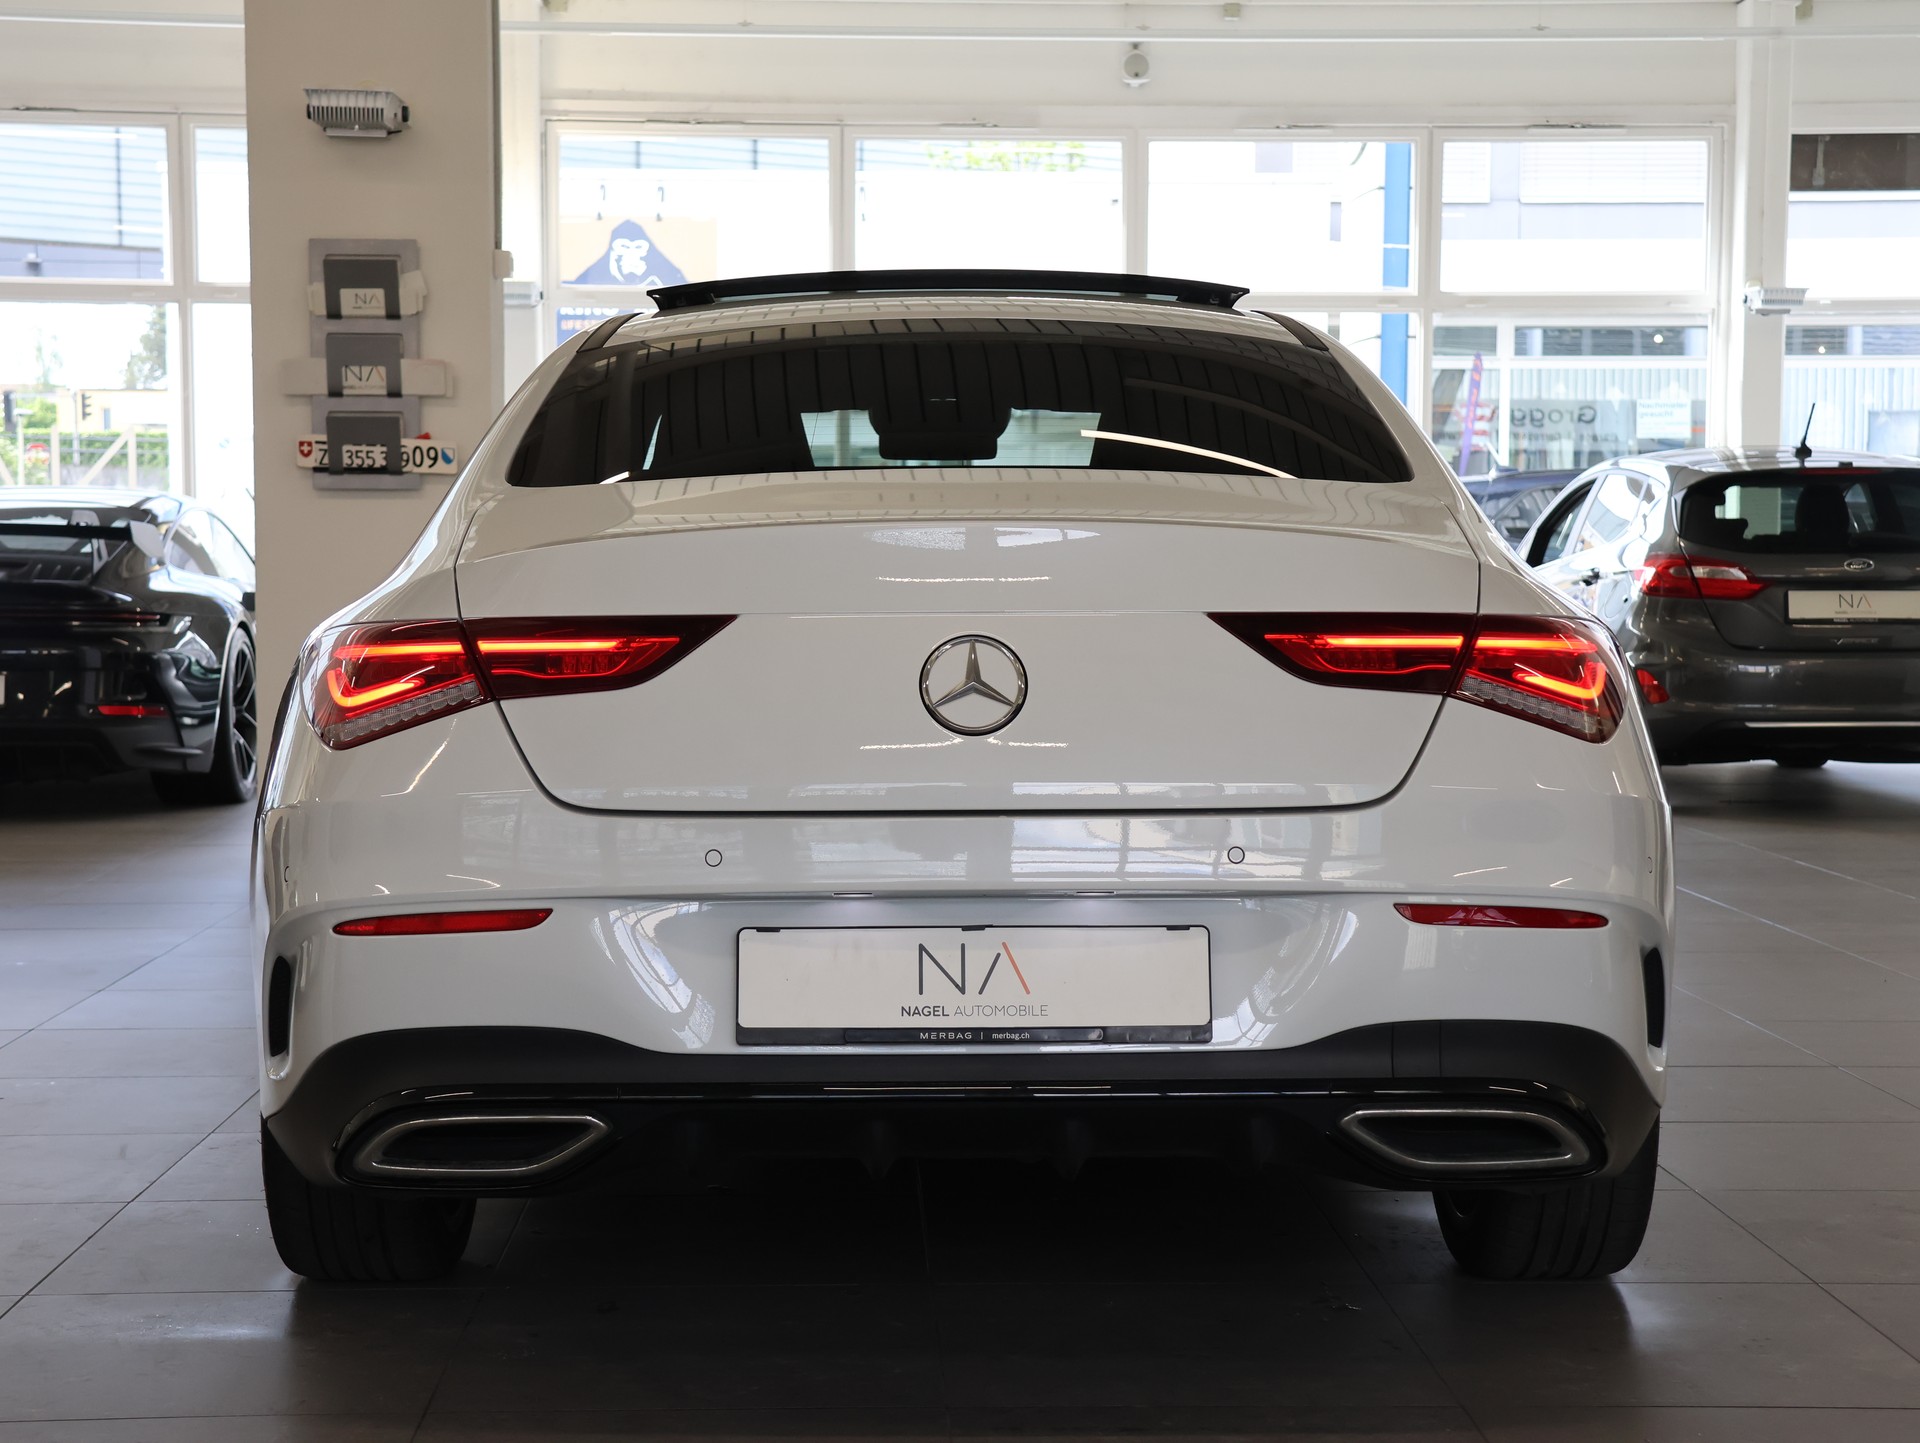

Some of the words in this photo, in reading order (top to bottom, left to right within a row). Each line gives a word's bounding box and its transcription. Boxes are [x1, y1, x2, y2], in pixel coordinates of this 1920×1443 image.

[901, 1005, 950, 1017] NAGEL
[953, 1004, 1049, 1017] AUTOMOBILE
[920, 1032, 972, 1040] MERBAG
[992, 1031, 1030, 1041] merbag.ch
